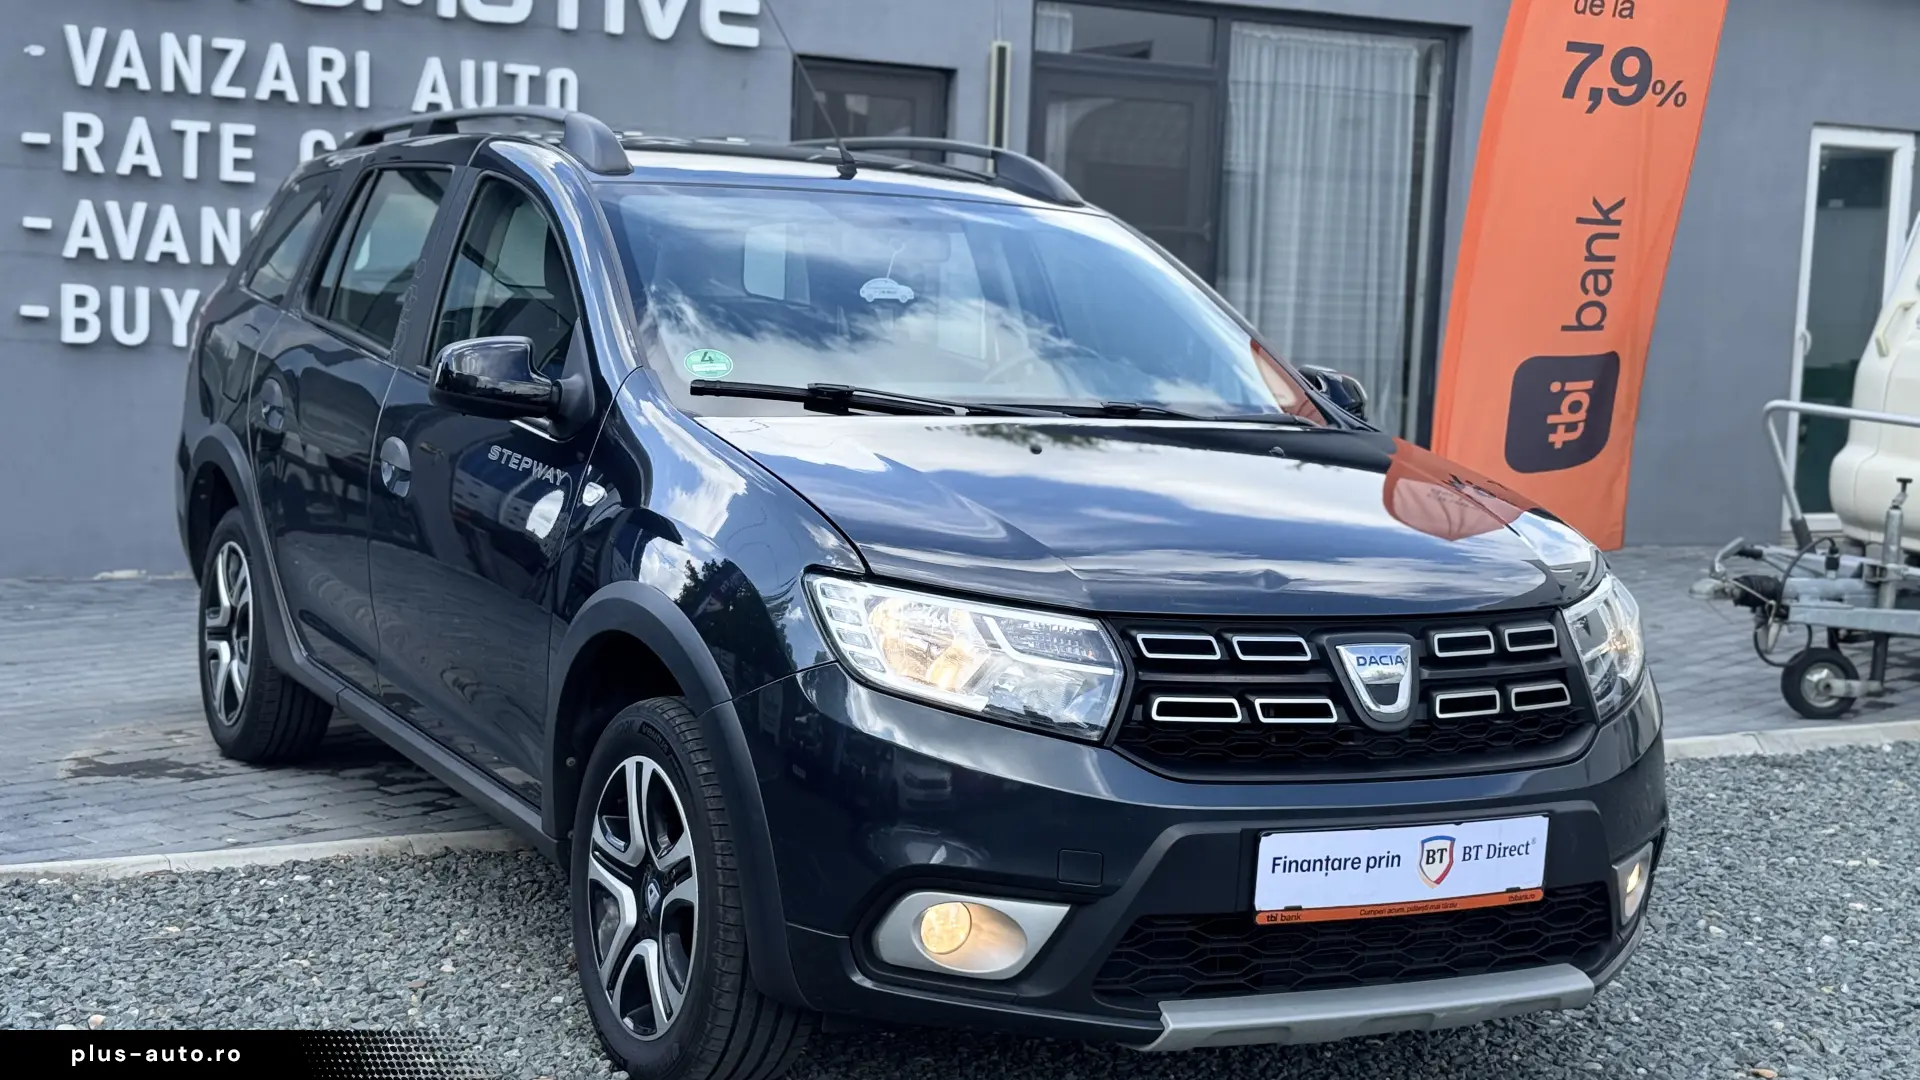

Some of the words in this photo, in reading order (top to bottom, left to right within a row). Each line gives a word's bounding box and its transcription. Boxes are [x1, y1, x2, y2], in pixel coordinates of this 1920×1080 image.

[411, 57, 579, 113] AUTO
[1562, 41, 1687, 114] 7,9%
[1561, 196, 1626, 331] bank
[701, 352, 714, 363] 4
[1547, 380, 1594, 449] tbi
[488, 445, 568, 486] STEPWAY
[1356, 655, 1405, 667] DACIA
[1271, 855, 1361, 877] Finanțare
[1366, 851, 1401, 873] prin
[1425, 848, 1447, 865] BT
[1461, 845, 1482, 862] BT
[1266, 913, 1278, 922] tbi
[1280, 912, 1302, 921] bank
